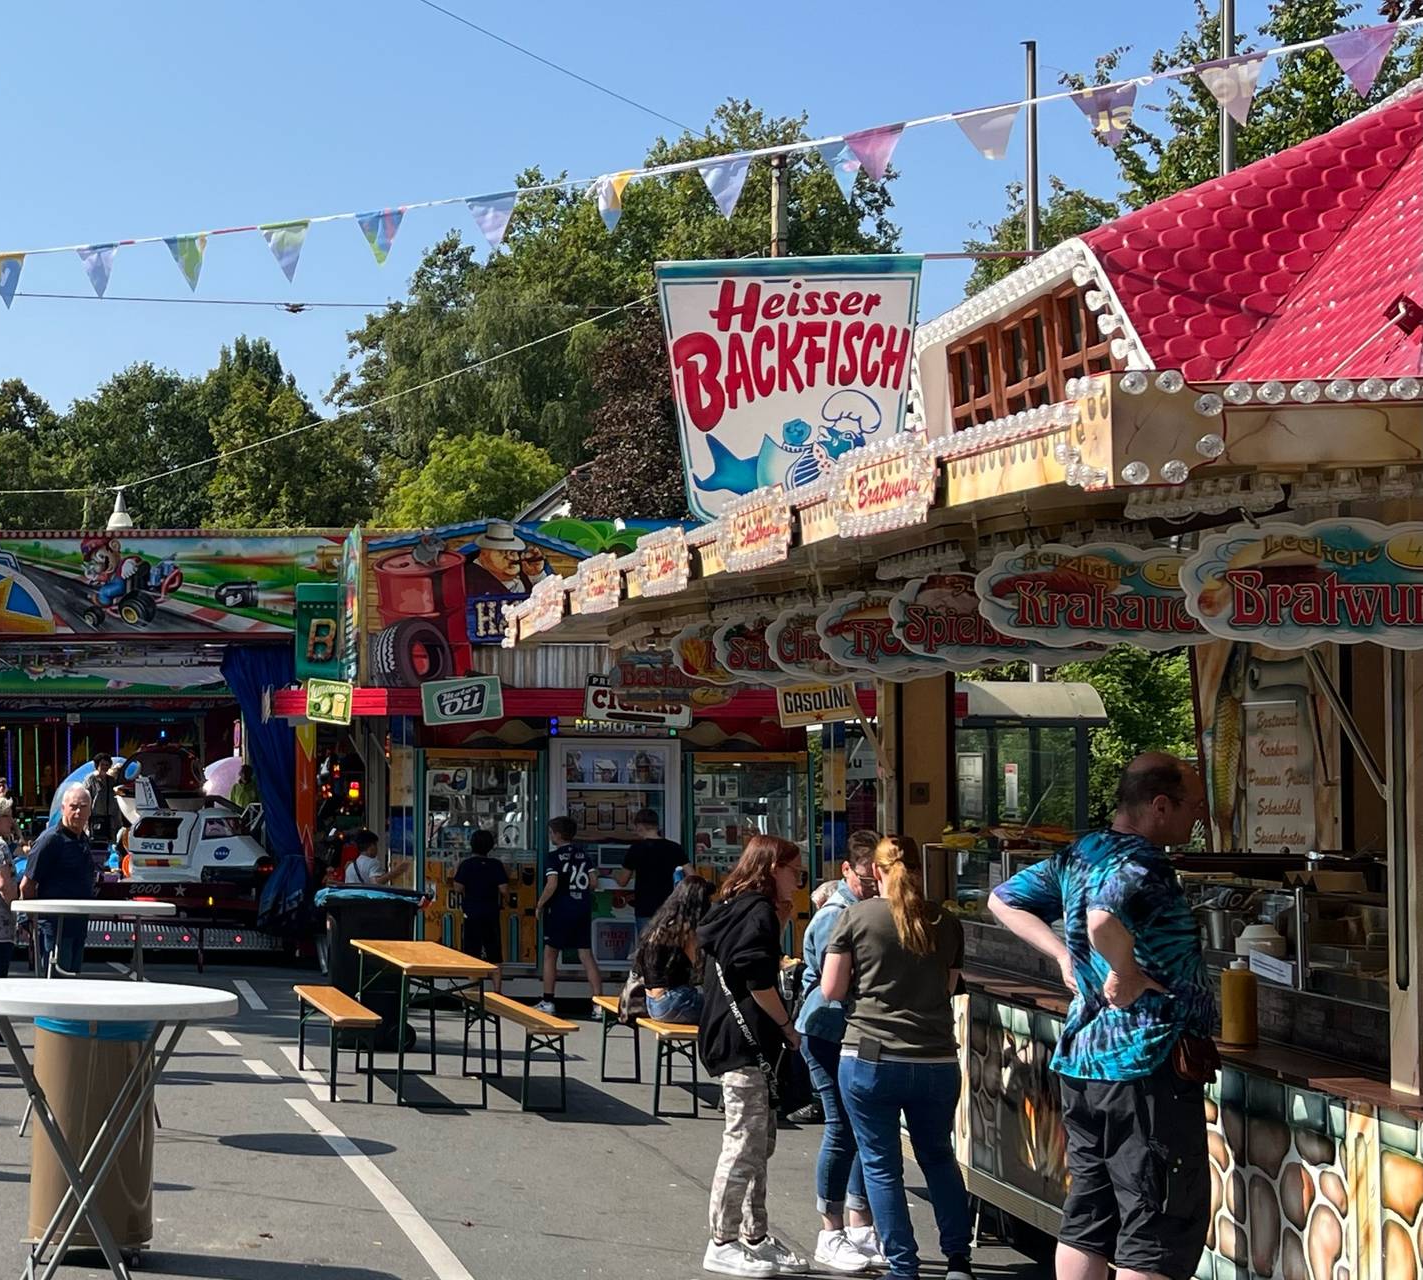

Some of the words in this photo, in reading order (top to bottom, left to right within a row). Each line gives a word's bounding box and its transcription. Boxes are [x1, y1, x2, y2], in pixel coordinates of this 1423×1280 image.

[709, 280, 882, 332] Heisser
[672, 320, 910, 432] BACKFISCH
[1262, 534, 1380, 566] Leckere
[1015, 580, 1206, 634] Krakaue
[441, 686, 479, 701] Motor
[441, 692, 482, 715] Oil
[129, 884, 162, 895] 2000
